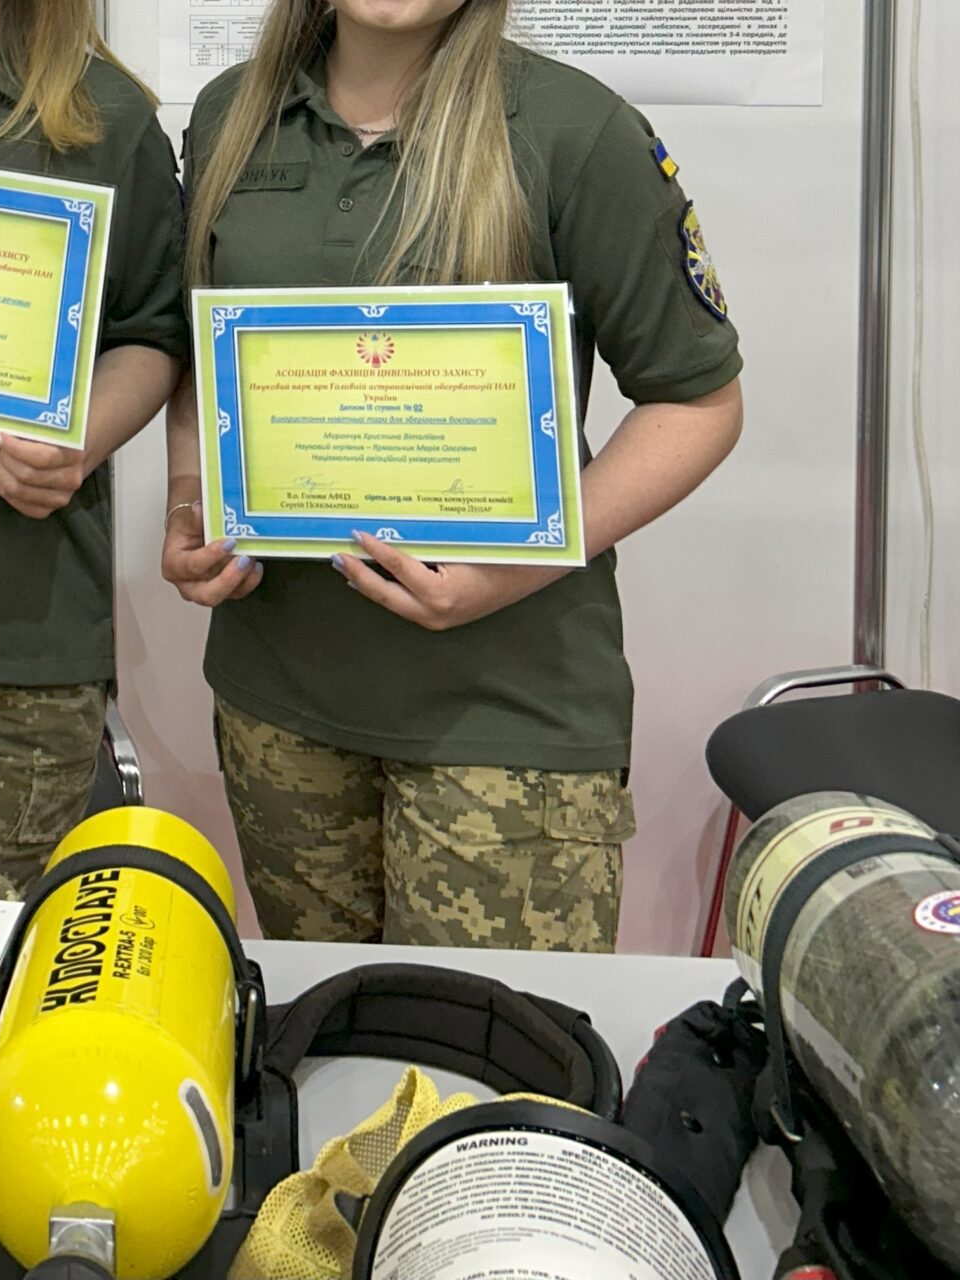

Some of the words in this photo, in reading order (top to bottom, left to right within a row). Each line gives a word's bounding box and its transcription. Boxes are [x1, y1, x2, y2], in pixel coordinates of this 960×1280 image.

[377, 369, 440, 378] ЦИВІЛЬНОГО
[443, 368, 487, 378] ЗАХИСТУ
[112, 929, 136, 980] R-EXTRA-5
[456, 1136, 529, 1154] WARNING
[561, 1149, 604, 1171] SPECIAL
[606, 1167, 634, 1187] CARE
